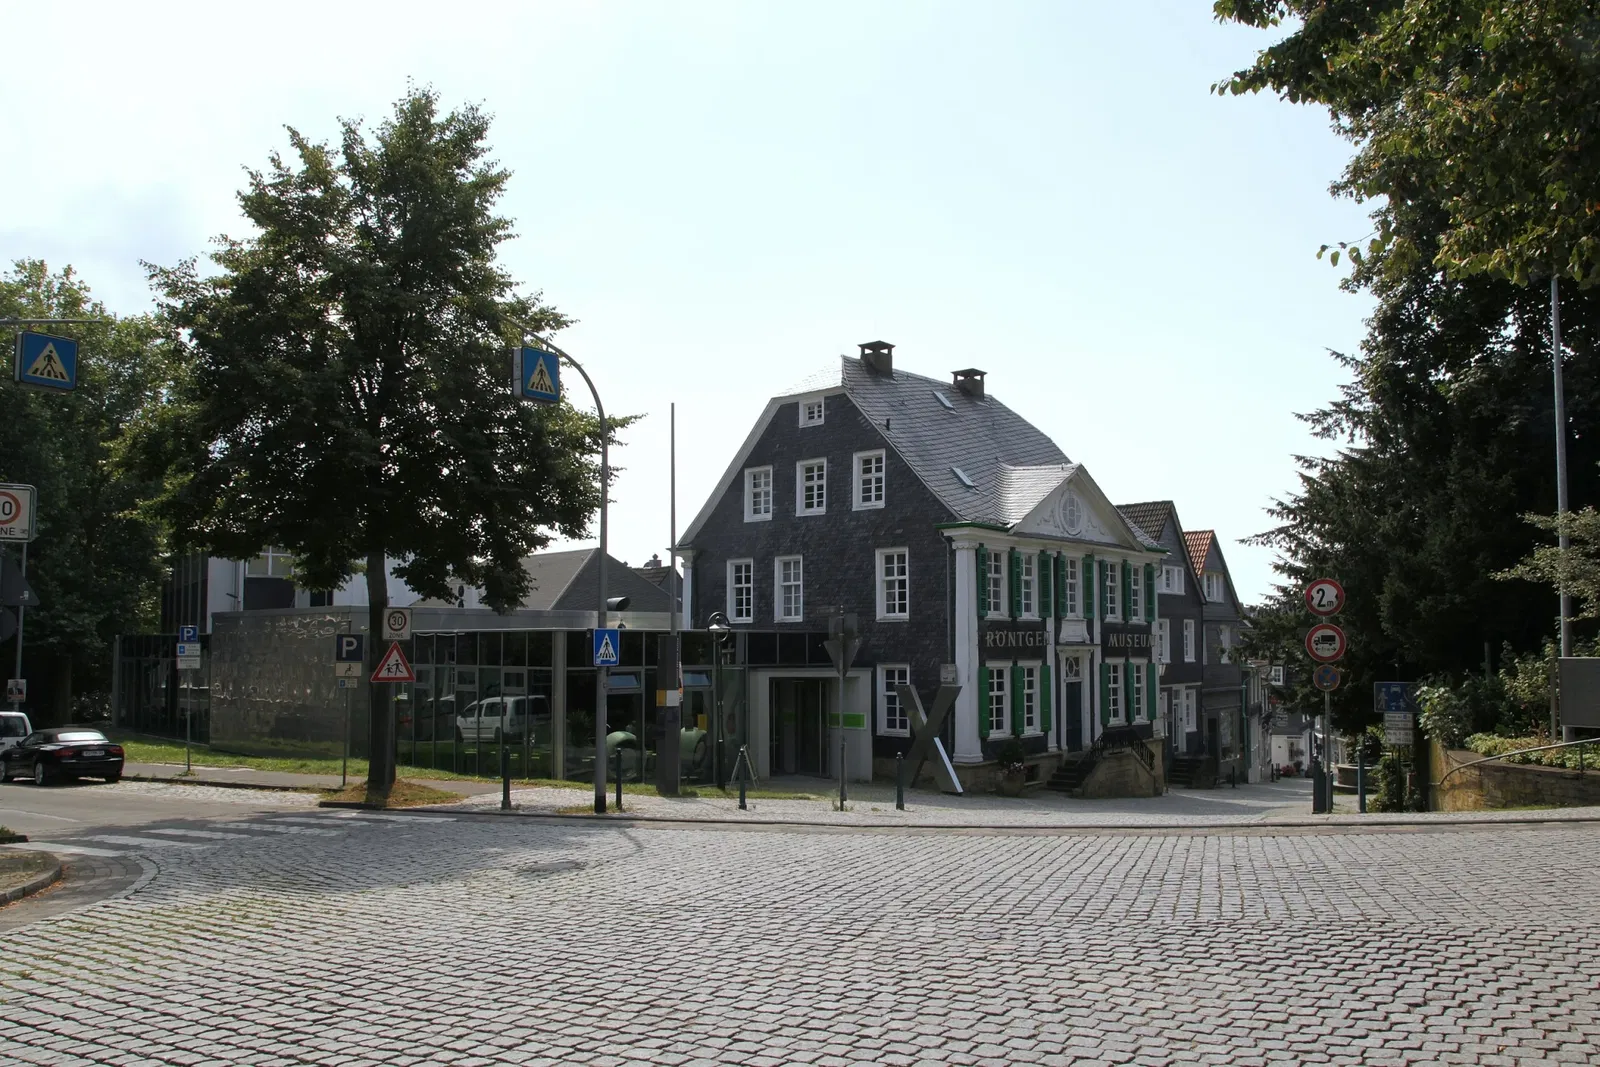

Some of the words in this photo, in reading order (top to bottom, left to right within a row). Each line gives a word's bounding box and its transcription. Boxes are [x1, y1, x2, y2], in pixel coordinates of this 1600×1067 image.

[1316, 588, 1326, 608] 2
[391, 616, 403, 626] 30
[183, 628, 194, 641] P
[985, 630, 1052, 648] RÖNTGEN
[1107, 633, 1157, 648] MUSEUM
[341, 637, 358, 658] P
